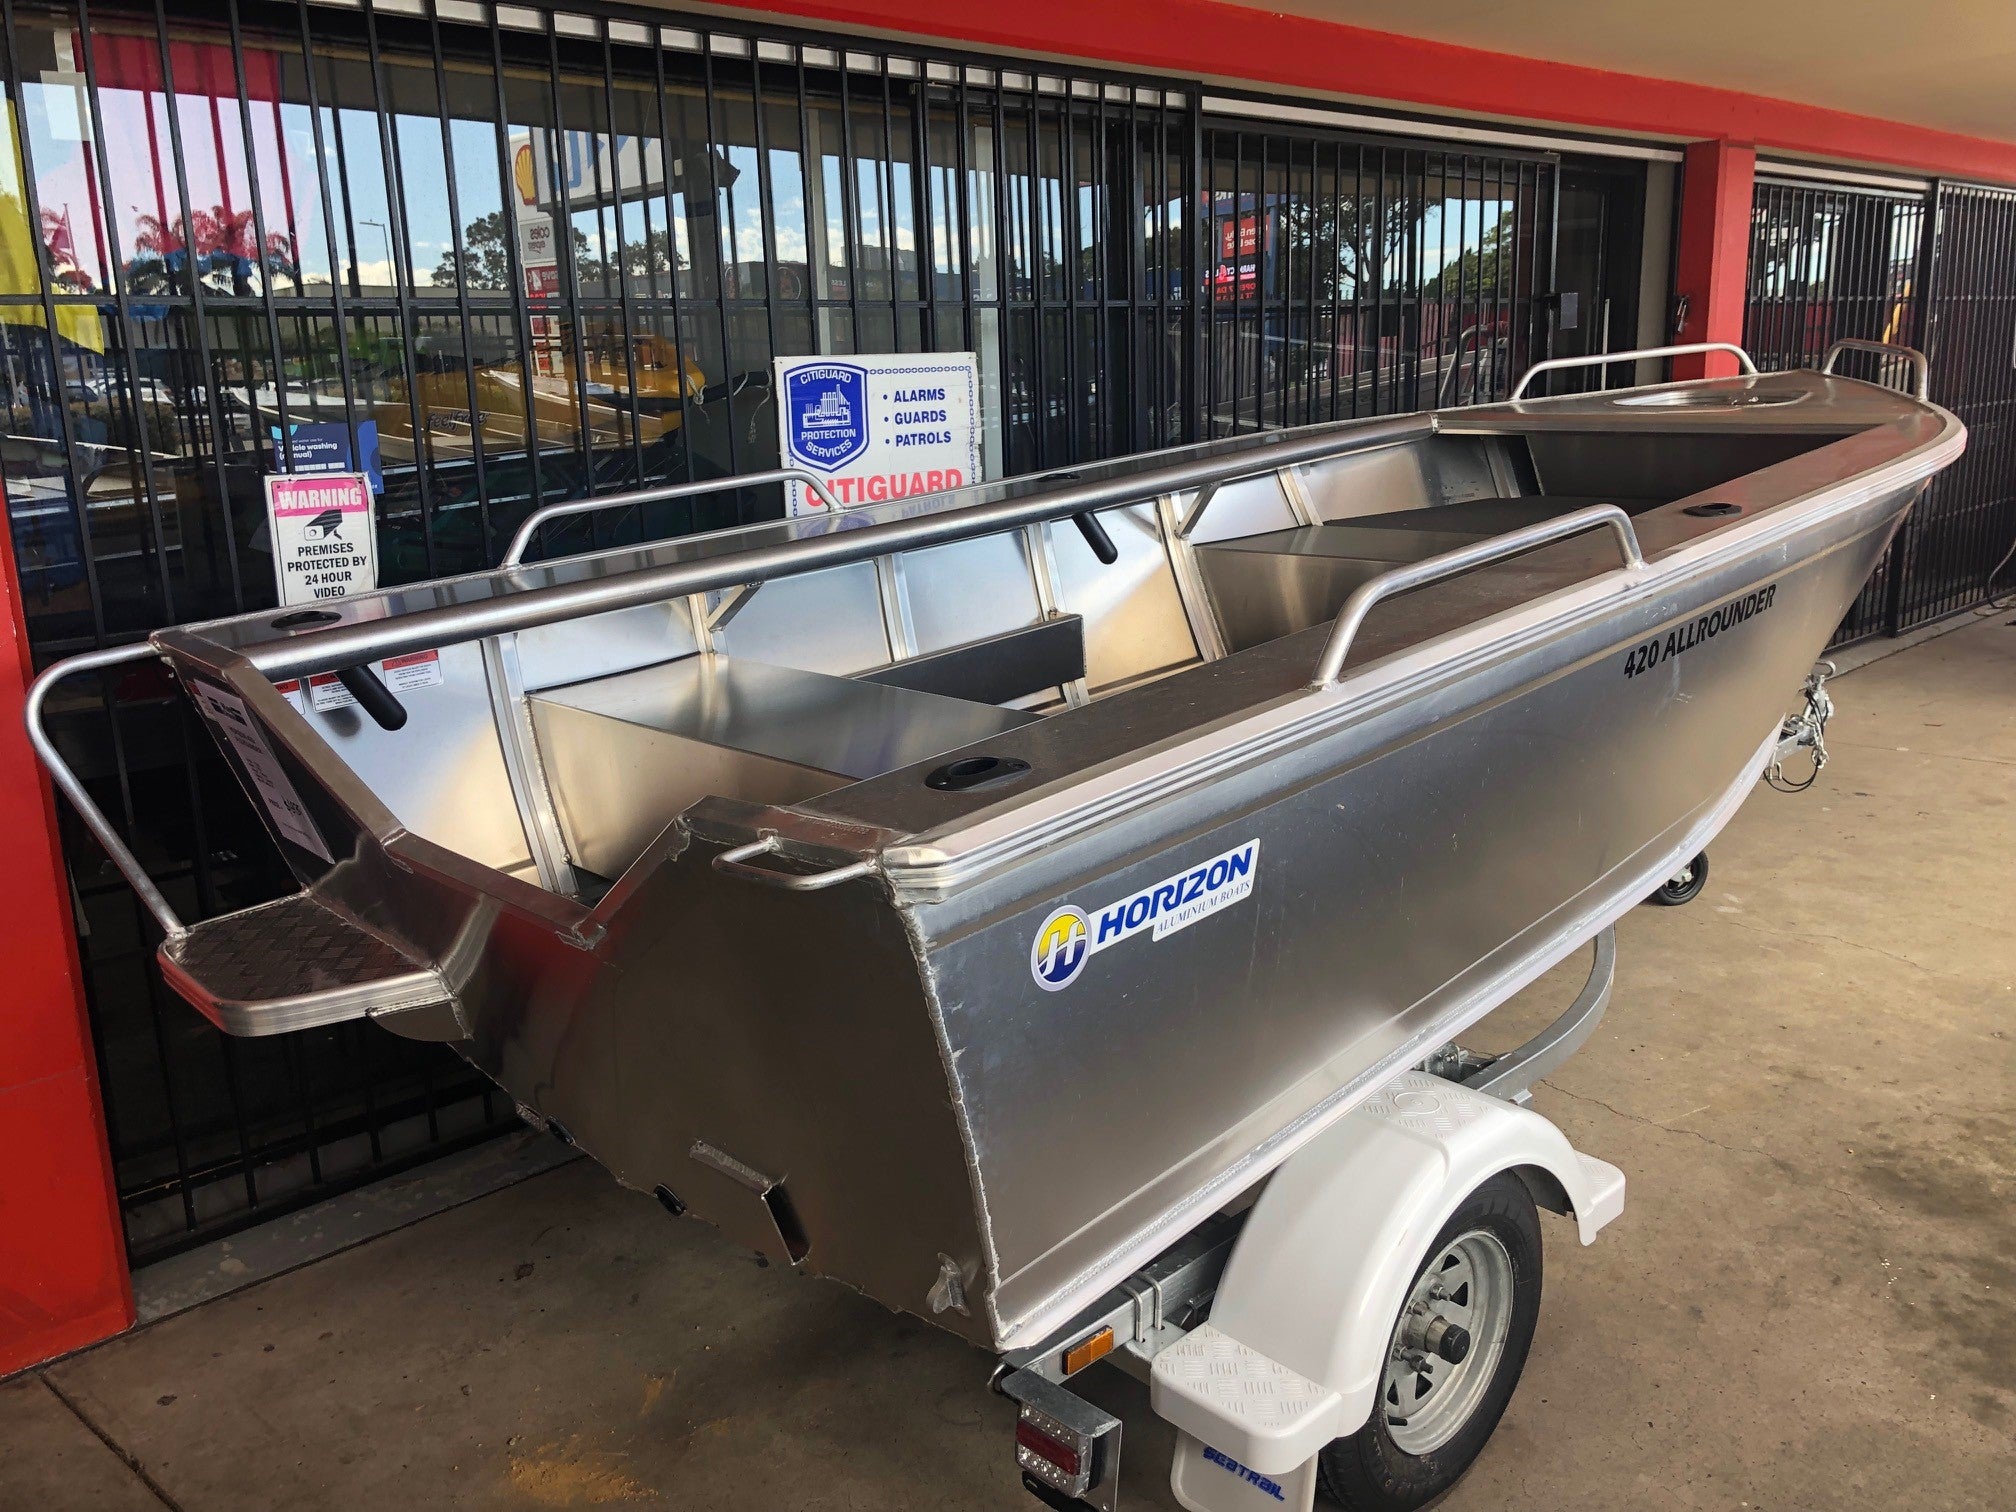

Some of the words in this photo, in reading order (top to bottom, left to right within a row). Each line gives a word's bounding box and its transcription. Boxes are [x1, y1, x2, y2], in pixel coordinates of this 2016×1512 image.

[800, 369, 852, 385] CITIGUARD
[893, 388, 946, 403] ALARMS
[894, 410, 947, 425] GUARDS
[801, 428, 857, 441] PROTECTION
[895, 431, 952, 447] PATROLS
[306, 441, 338, 451] washing
[805, 439, 853, 458] SERVICES
[278, 487, 362, 510] WARNING
[297, 542, 354, 557] PREMISES
[287, 557, 350, 572] PROTECTED
[352, 555, 367, 567] BY
[305, 574, 319, 586] 24
[321, 571, 352, 584] HOUR
[313, 585, 346, 599] VIDEO
[1623, 640, 1660, 679] 420
[1661, 583, 1777, 662] ALLROUNDER
[1097, 846, 1253, 945] HORIZON
[1156, 897, 1219, 934] ALUMINIUM
[1219, 880, 1251, 905] BOATS
